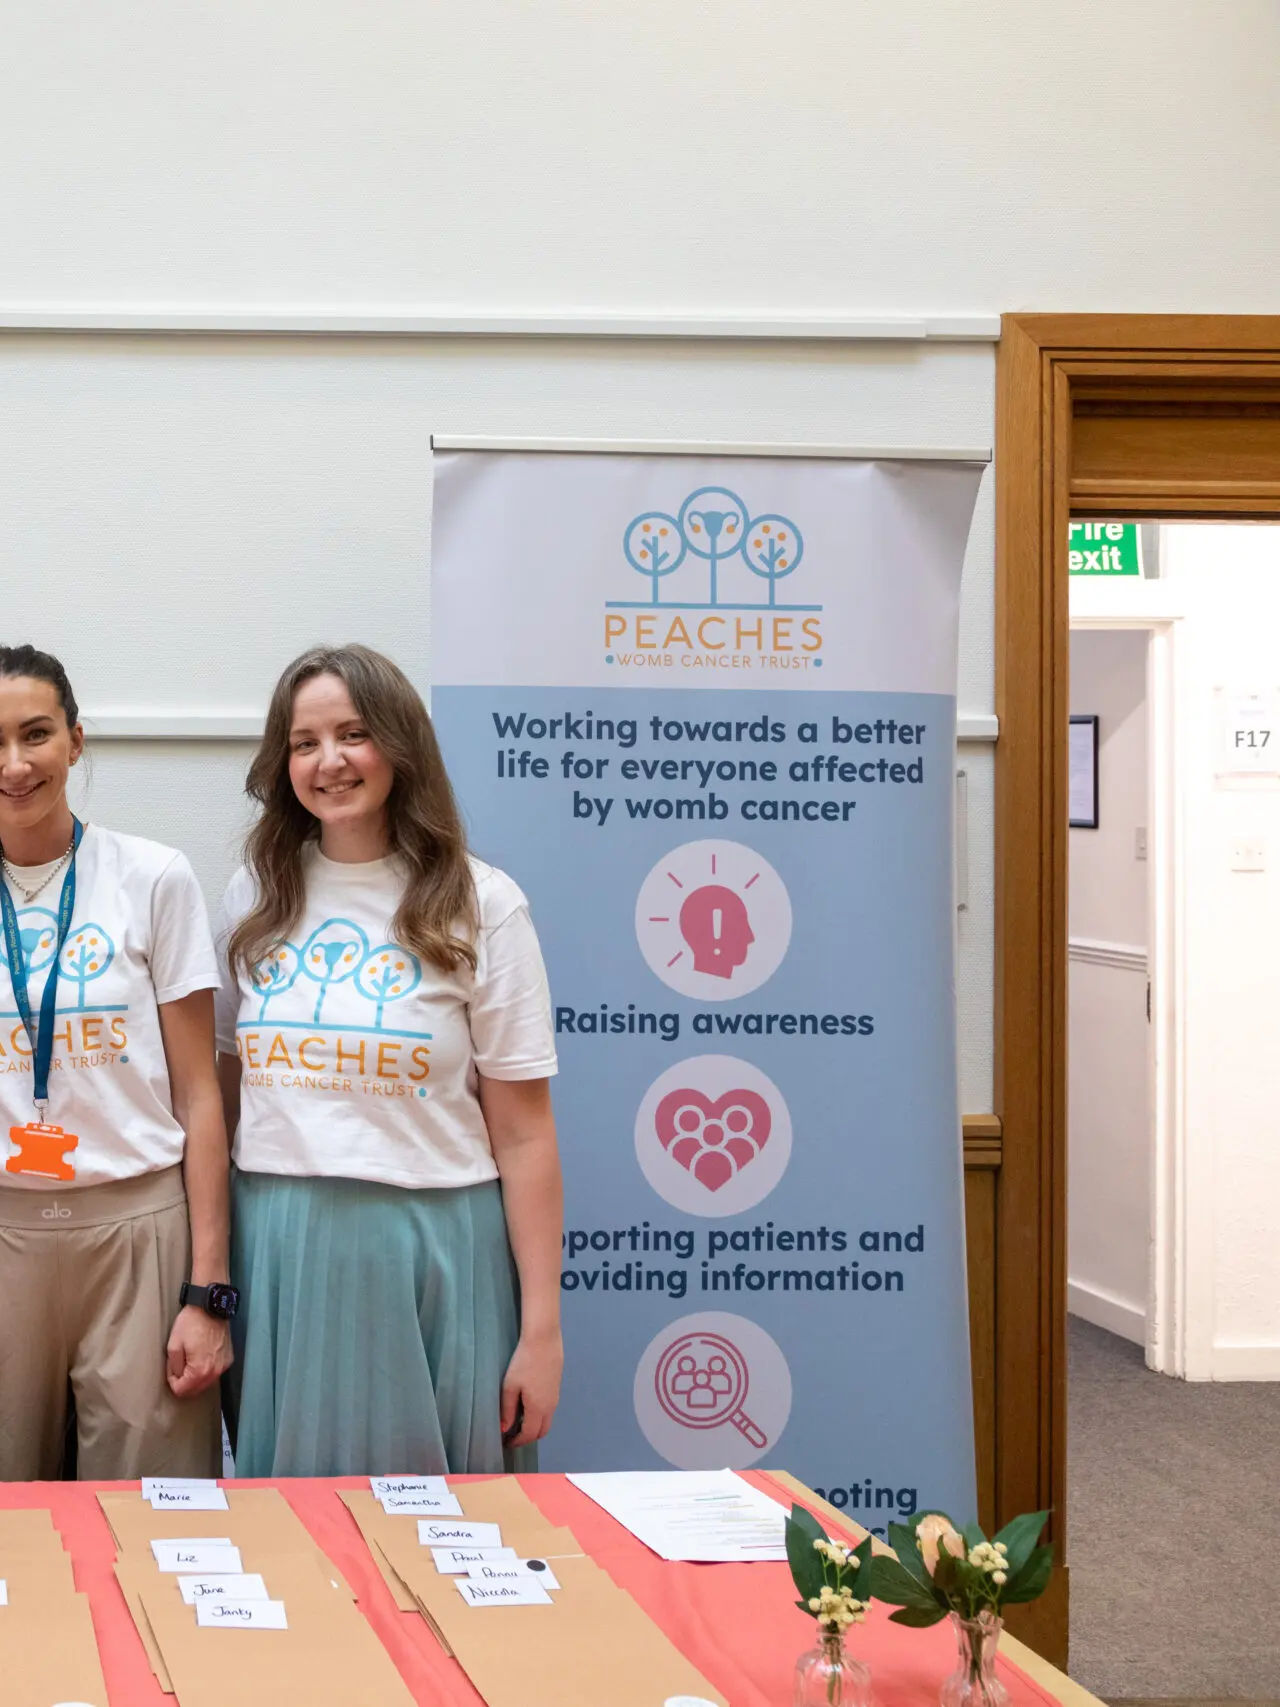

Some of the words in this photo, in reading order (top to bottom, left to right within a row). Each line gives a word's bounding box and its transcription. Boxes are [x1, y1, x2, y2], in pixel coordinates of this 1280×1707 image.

[1069, 545, 1123, 571] exit
[604, 614, 823, 652] PEACHES
[616, 653, 674, 667] WOMB
[681, 654, 752, 669] CANCER
[759, 655, 811, 670] TRUST
[492, 711, 638, 748] Working
[650, 715, 787, 743] towards
[797, 721, 818, 743] a
[832, 716, 926, 745] better
[1235, 730, 1271, 748] F17
[497, 749, 550, 779] life
[561, 751, 609, 779] for
[620, 758, 778, 788] everyone
[788, 755, 924, 783] affected
[573, 791, 614, 826] by
[625, 793, 729, 820] womb
[740, 798, 856, 821] cancer
[555, 1004, 680, 1041] Raising
[692, 1011, 875, 1036] awareness
[71, 1053, 118, 1069] TRUST
[280, 1074, 353, 1092] CANCER
[361, 1081, 416, 1099] TRUST
[41, 1200, 72, 1219] alo
[561, 1221, 695, 1259] porting
[708, 1222, 847, 1258] patients
[858, 1225, 925, 1252] and
[560, 1261, 687, 1299] oviding
[701, 1262, 904, 1292] information
[158, 1492, 192, 1501] Marie
[377, 1481, 429, 1494] Stephanie
[387, 1497, 442, 1507] Samantha
[428, 1526, 473, 1540] Sandra
[176, 1553, 199, 1563] Liz
